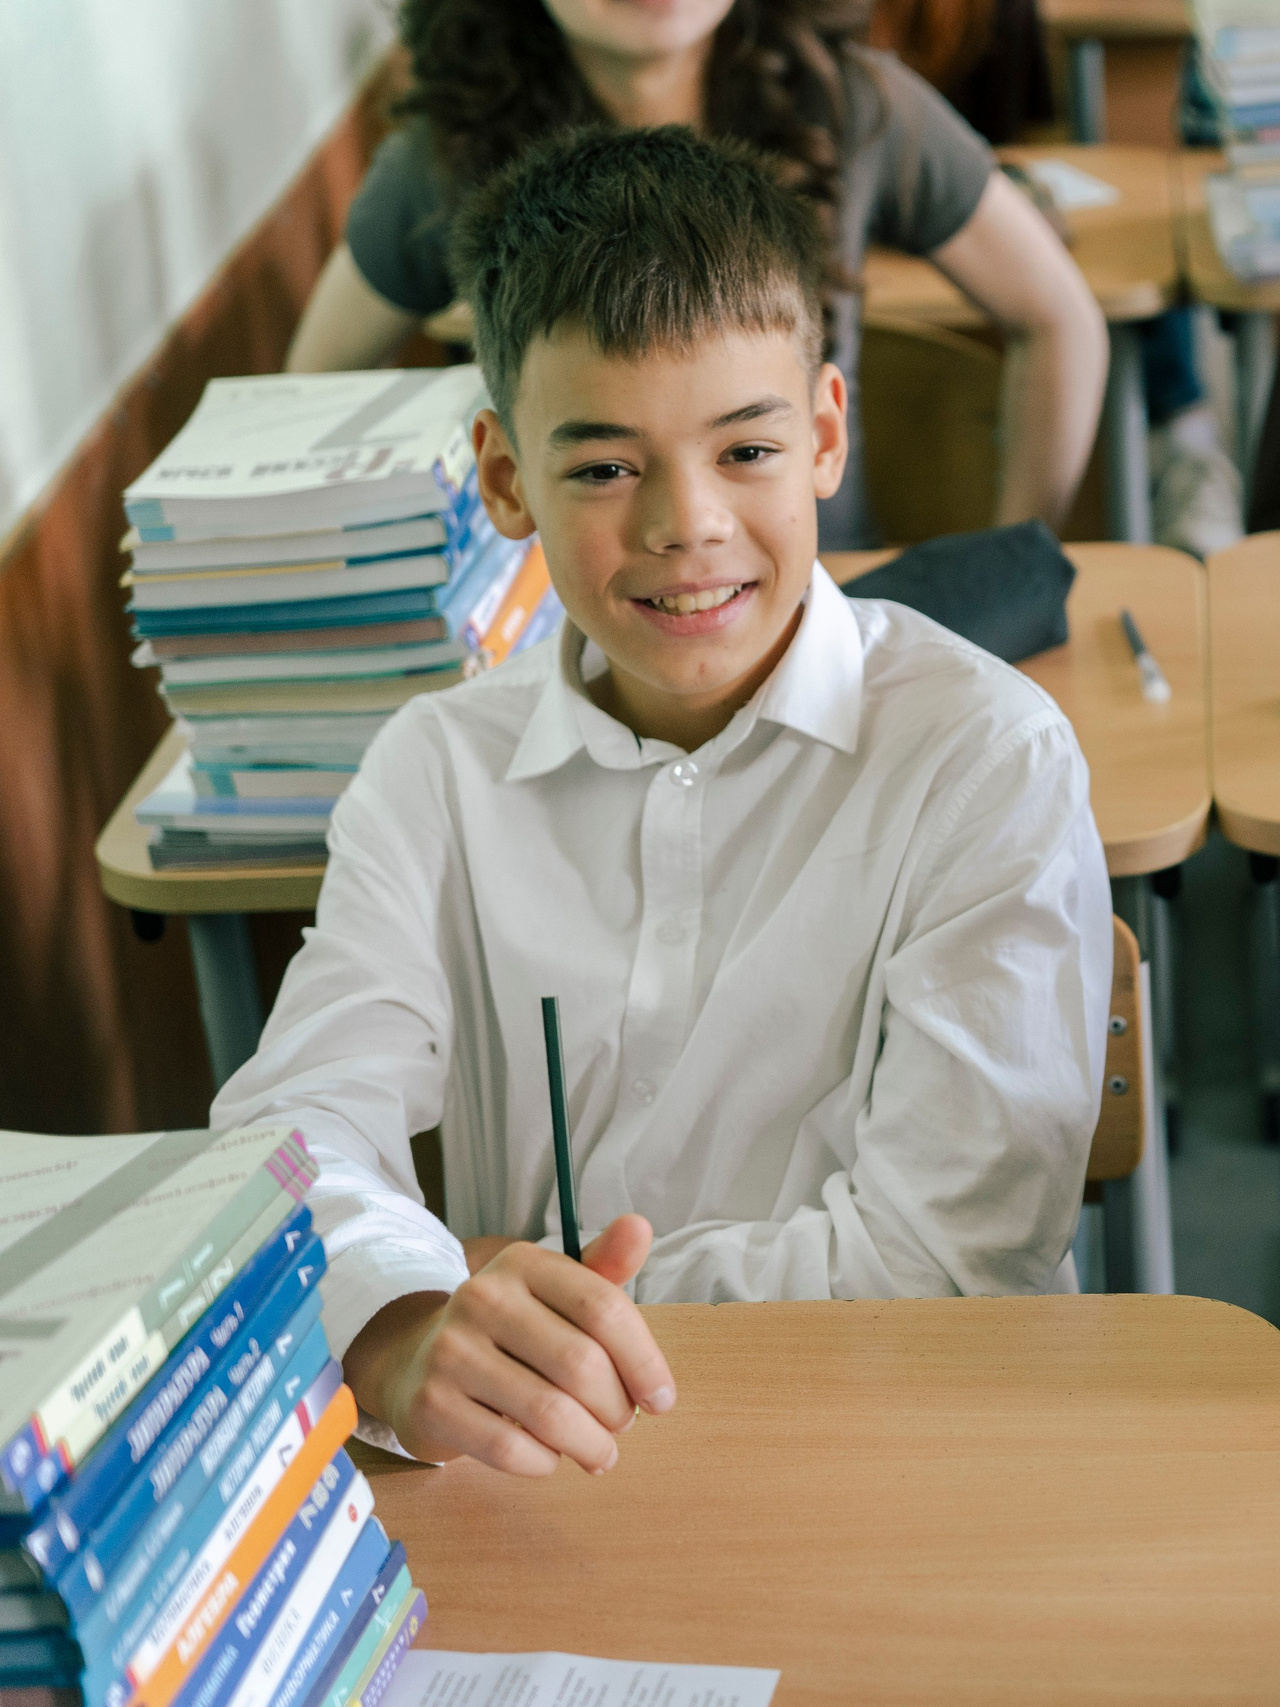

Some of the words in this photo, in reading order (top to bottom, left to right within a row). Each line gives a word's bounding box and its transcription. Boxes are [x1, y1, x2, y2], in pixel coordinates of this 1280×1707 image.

[284, 1229, 301, 1253] 7
[297, 1264, 314, 1287] 7
[275, 1332, 293, 1357] 7
[284, 1375, 300, 1399] 7
[277, 1443, 293, 1468] 7
[340, 1587, 354, 1608] 7
[371, 1583, 385, 1605] 7
